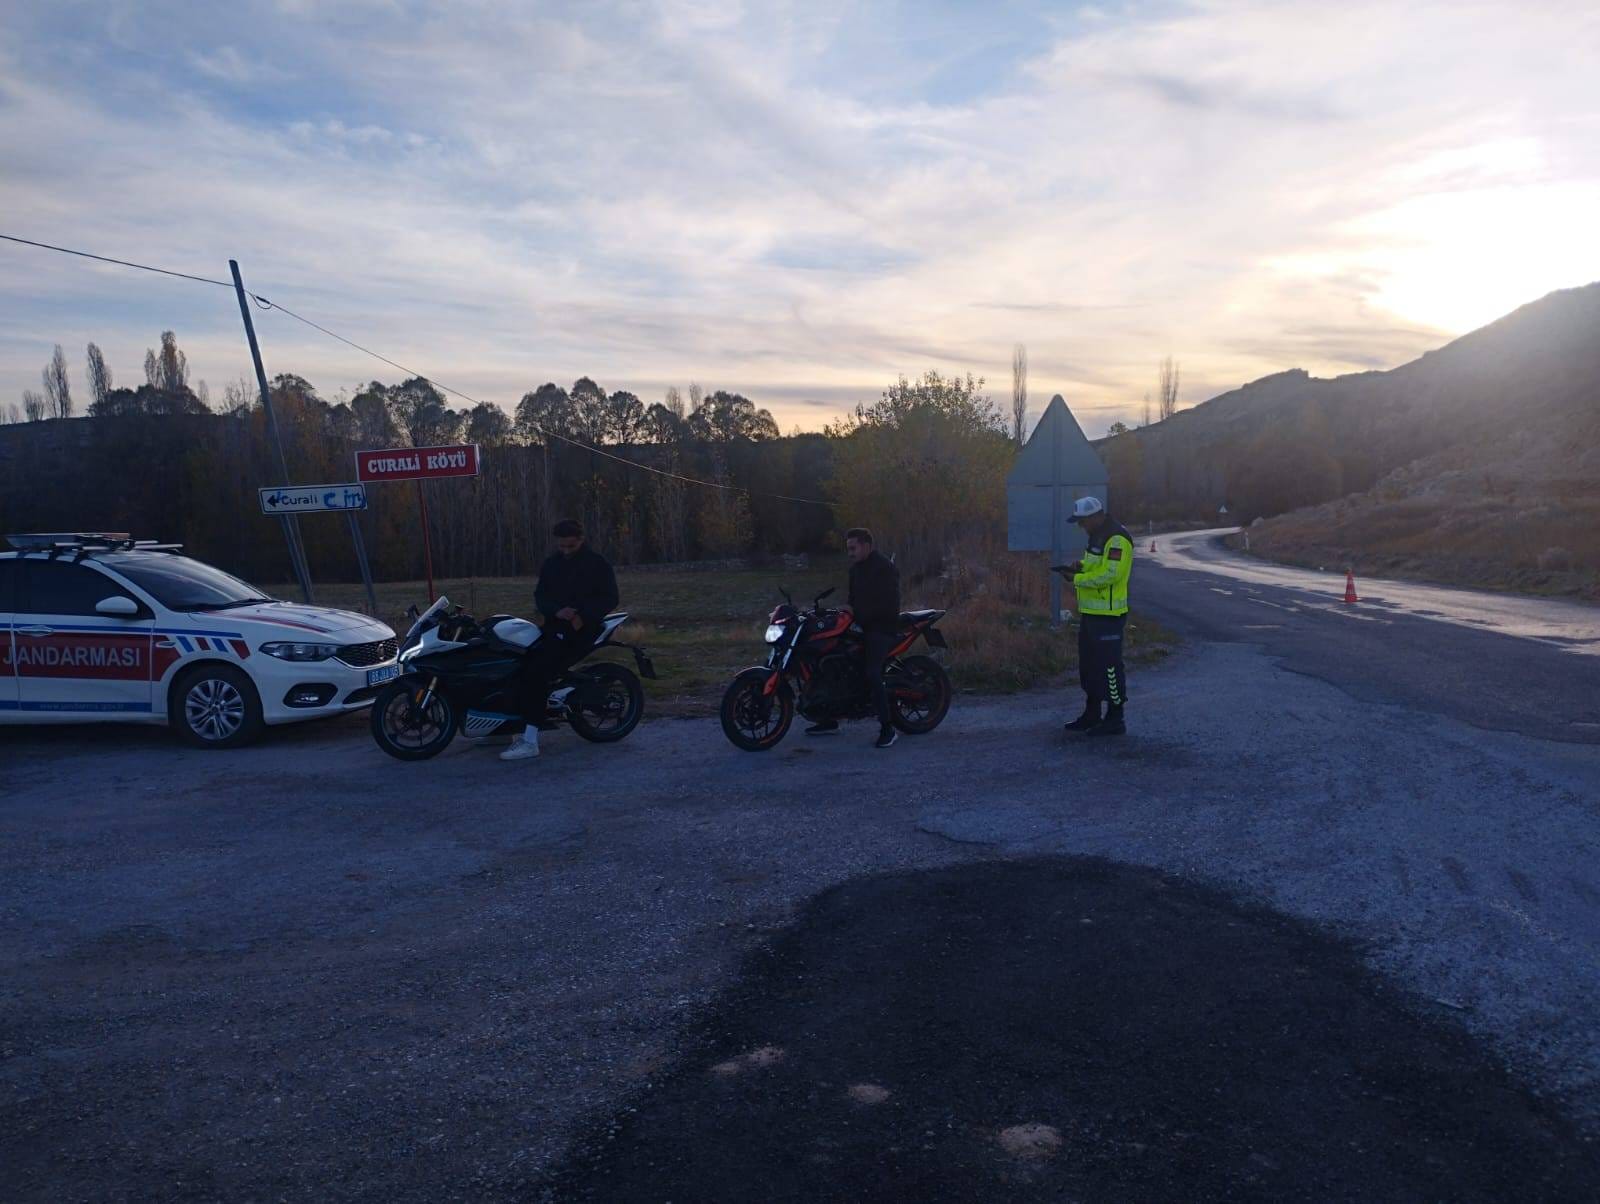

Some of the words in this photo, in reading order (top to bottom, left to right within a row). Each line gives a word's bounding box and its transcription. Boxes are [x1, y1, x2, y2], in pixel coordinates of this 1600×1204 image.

[367, 453, 421, 474] CURALİ
[427, 450, 467, 470] KÖYÜ
[3, 646, 141, 667] JANDARMASI
